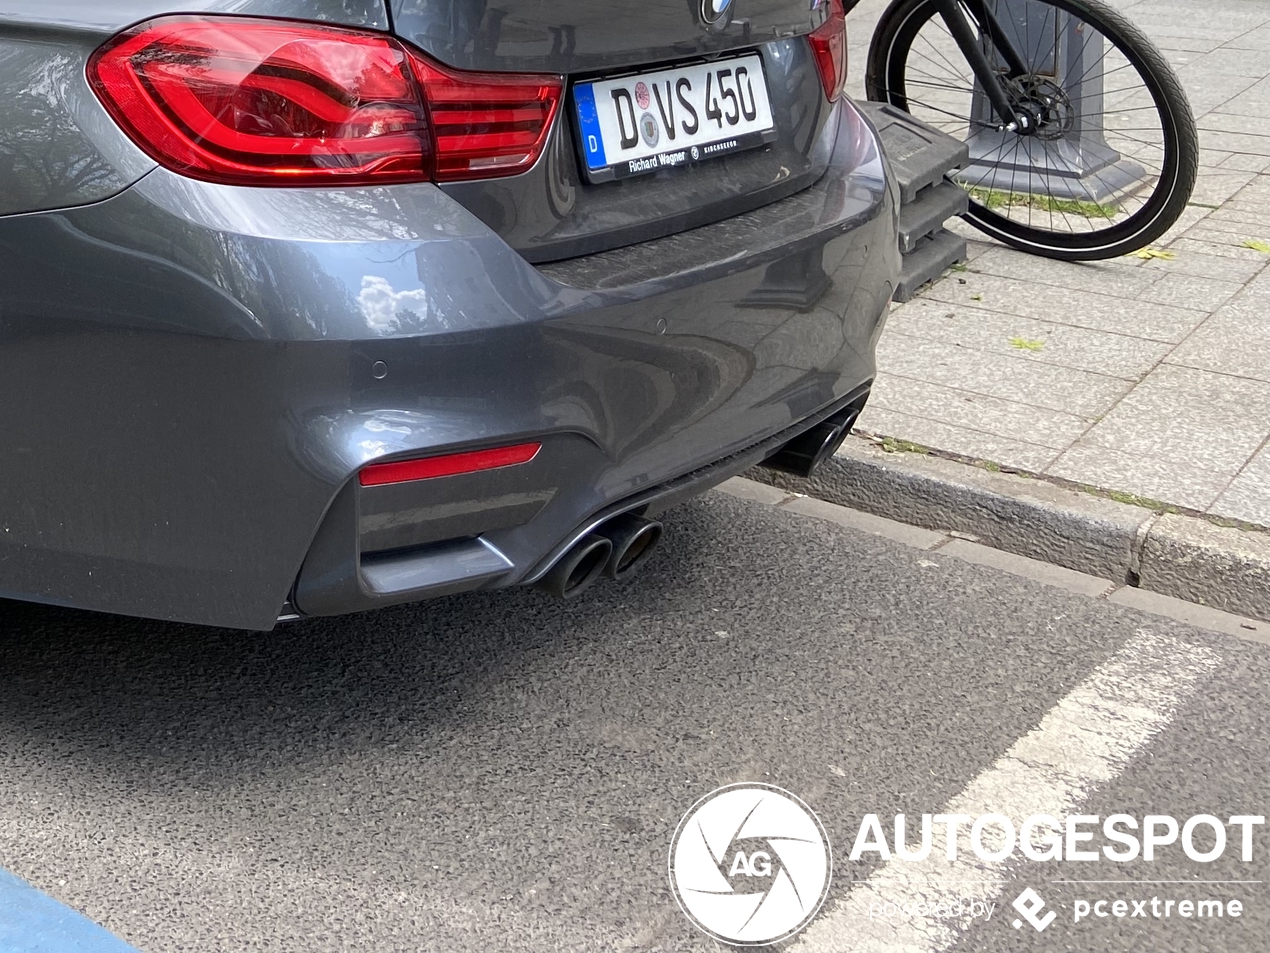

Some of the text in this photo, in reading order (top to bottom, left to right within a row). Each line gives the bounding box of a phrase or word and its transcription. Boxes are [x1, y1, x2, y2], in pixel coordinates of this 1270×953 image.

[610, 66, 757, 150] D VS 450
[588, 134, 598, 153] D
[628, 157, 658, 173] Richard
[658, 151, 686, 167] Wagner
